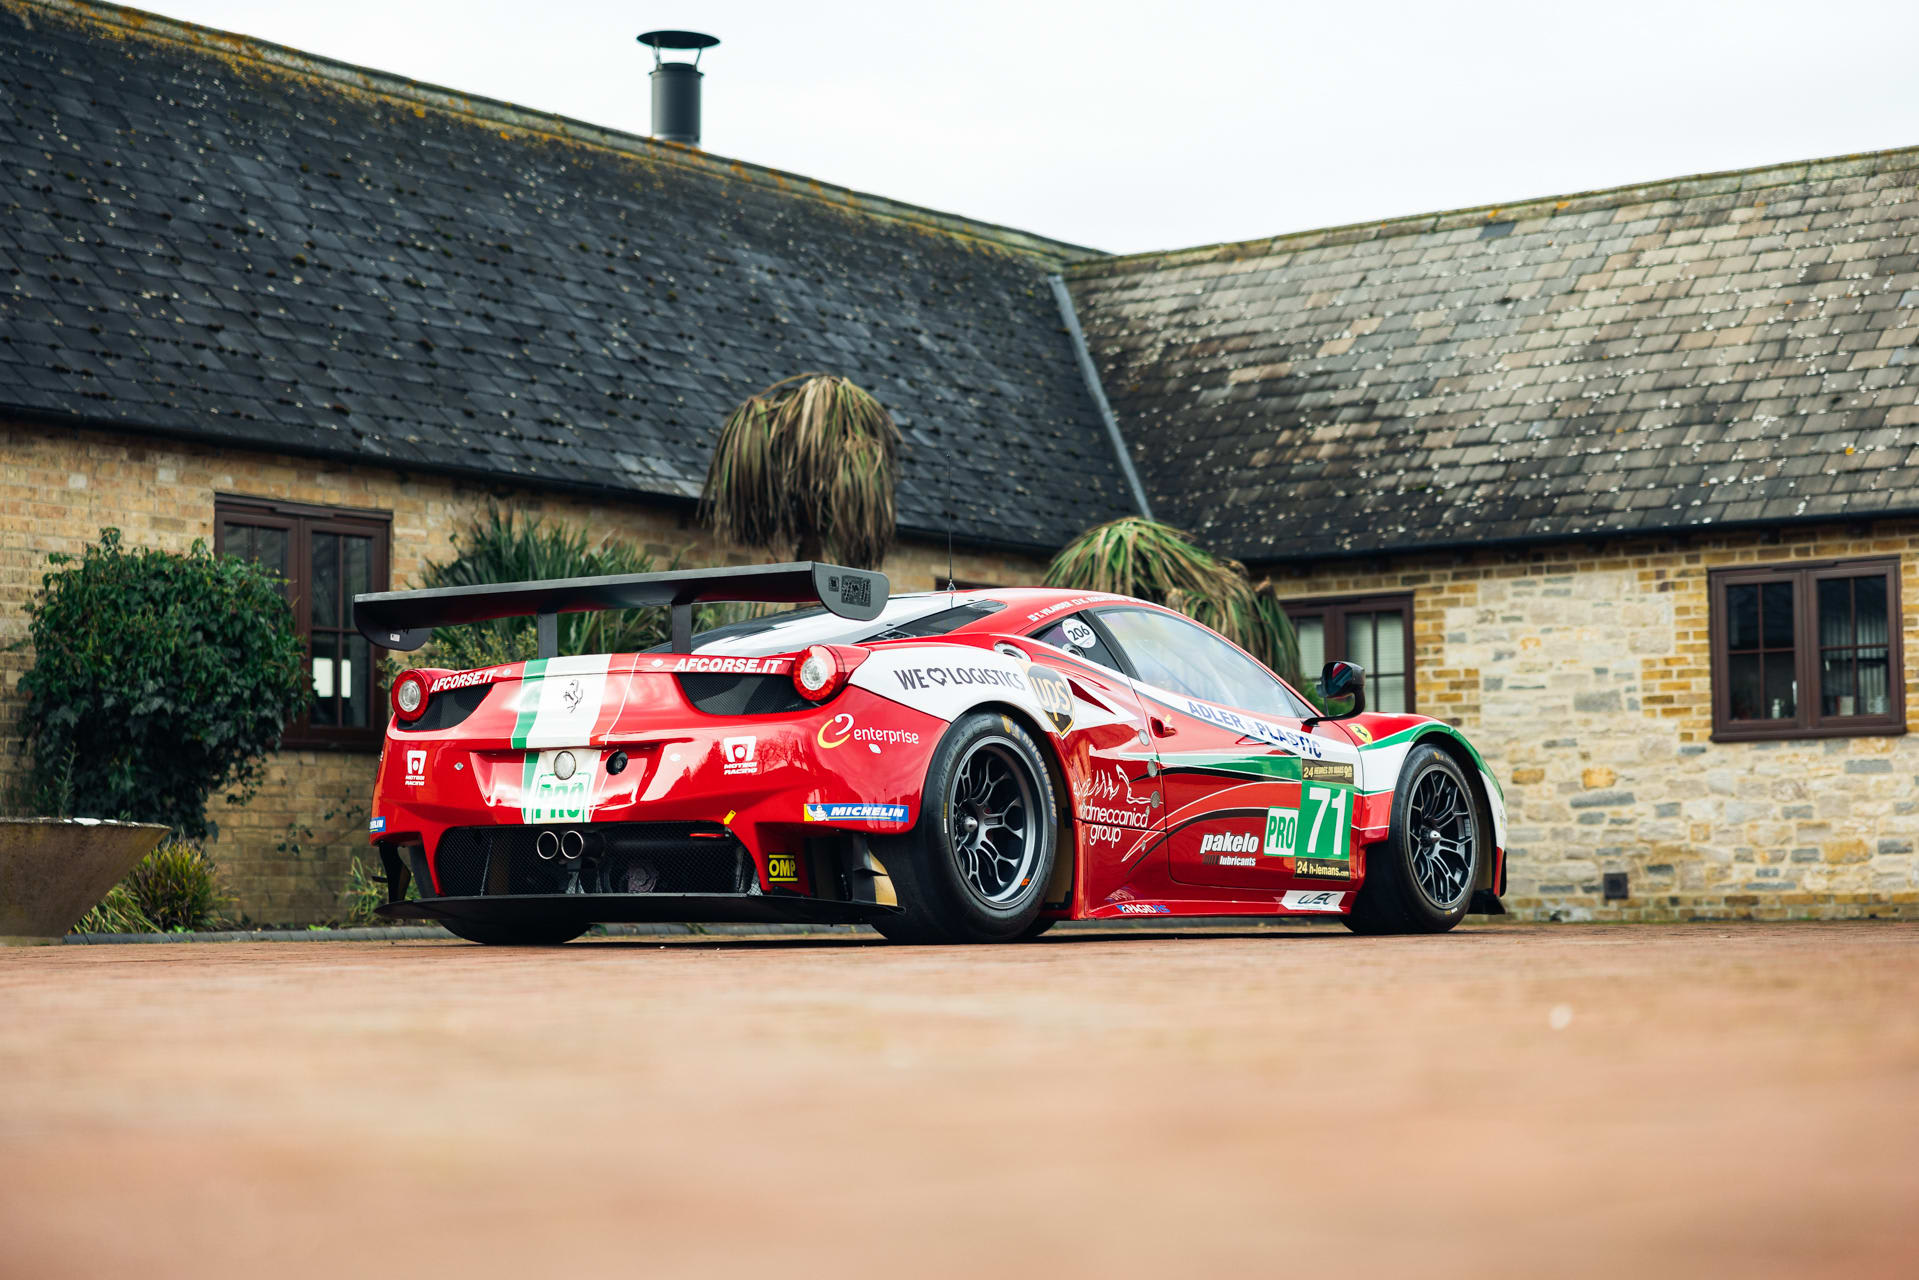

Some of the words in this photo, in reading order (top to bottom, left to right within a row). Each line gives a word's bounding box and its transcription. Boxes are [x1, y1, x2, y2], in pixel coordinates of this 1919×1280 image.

[1067, 625, 1091, 642] 206
[673, 658, 783, 674] AFCORSE.IT
[430, 669, 498, 693] AFCORSE.IT
[893, 668, 930, 690] WE
[945, 667, 1026, 691] LOGISTICS
[853, 727, 920, 745] enterprise
[1187, 701, 1246, 730] ADLER
[1254, 721, 1323, 759] PLASTIC
[1303, 766, 1314, 779] 24
[829, 806, 905, 818] MICHELIN
[1306, 786, 1347, 856] 71
[1089, 824, 1122, 849] group
[1265, 815, 1297, 850] PRO
[1199, 832, 1260, 854] pakelo
[768, 860, 797, 877] OMP
[1218, 855, 1257, 867] lubricants
[1296, 860, 1308, 875] 24
[1297, 892, 1338, 906] WEC
